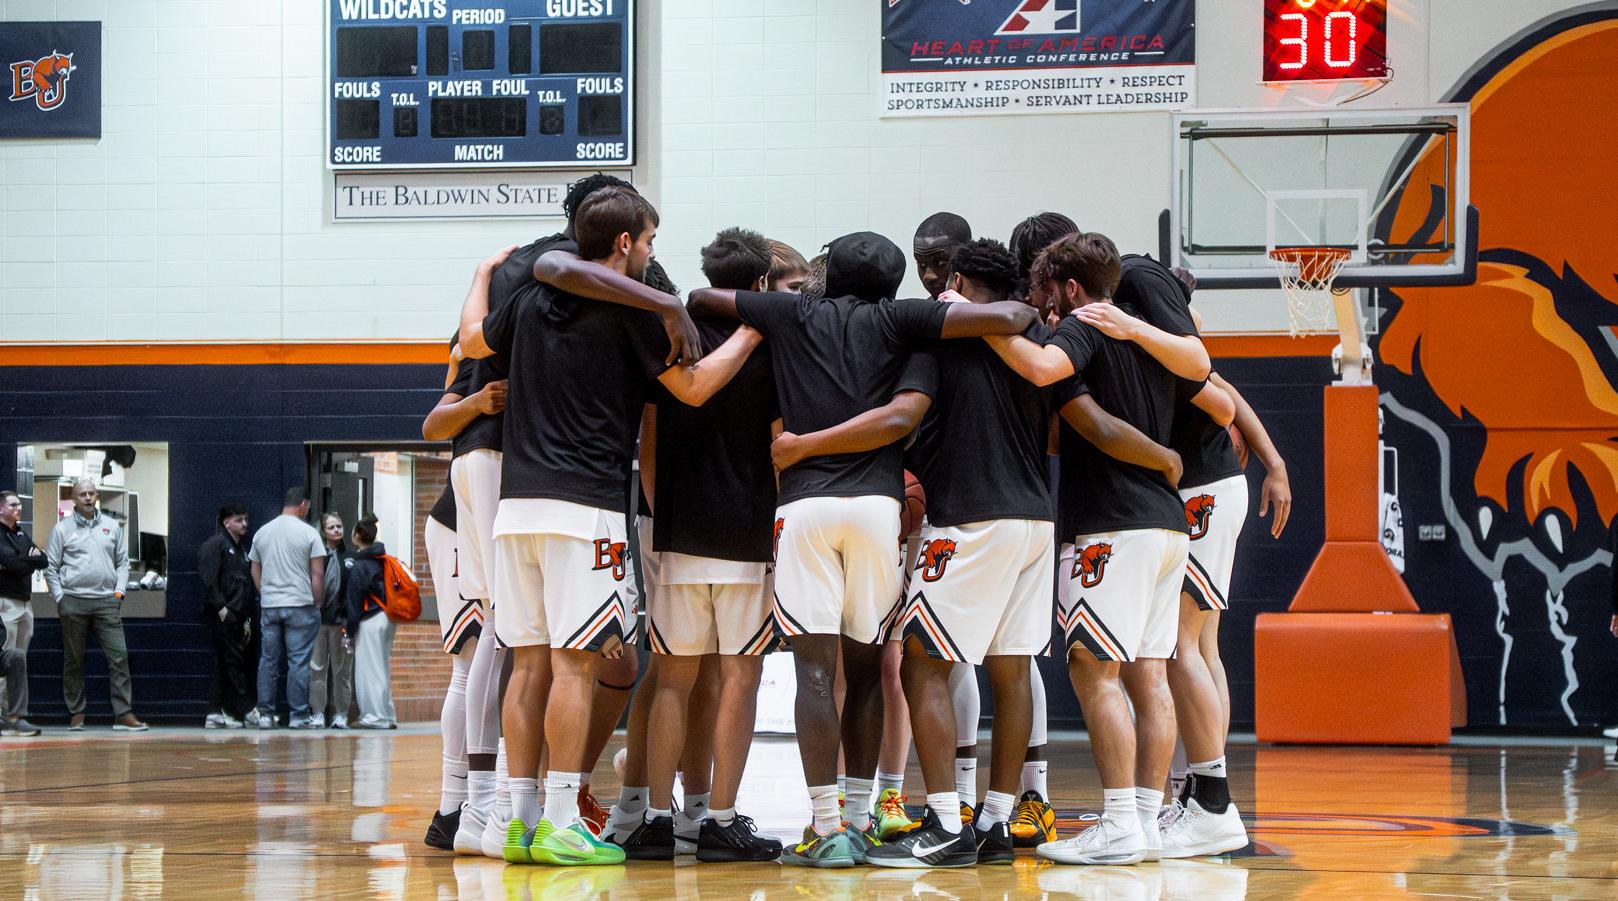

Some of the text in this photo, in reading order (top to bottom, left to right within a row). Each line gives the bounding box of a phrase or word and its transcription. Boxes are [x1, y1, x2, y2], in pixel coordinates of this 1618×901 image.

[338, 0, 447, 20] WILDCATS
[452, 8, 505, 25] PERIOD
[546, 0, 613, 17] GUEST
[910, 33, 1165, 56] HEART OF AMERICA
[1279, 11, 1357, 69] 30
[943, 52, 1130, 65] ATHLETIC CONFERENCE
[334, 81, 381, 98] FOULS
[428, 80, 530, 97] PLAYER FOUL
[576, 77, 624, 94] FOULS
[890, 75, 1186, 94] INTEGRITY RESPONSIBILITY RESPECT
[391, 93, 420, 106] T.O.L.
[538, 90, 566, 104] T.O.L.
[887, 91, 1189, 110] SPORTSMANSHIP SERVANT LEADERSHIP
[334, 146, 381, 162] SCORE
[454, 144, 504, 161] MATCH
[576, 142, 624, 159] SCORE
